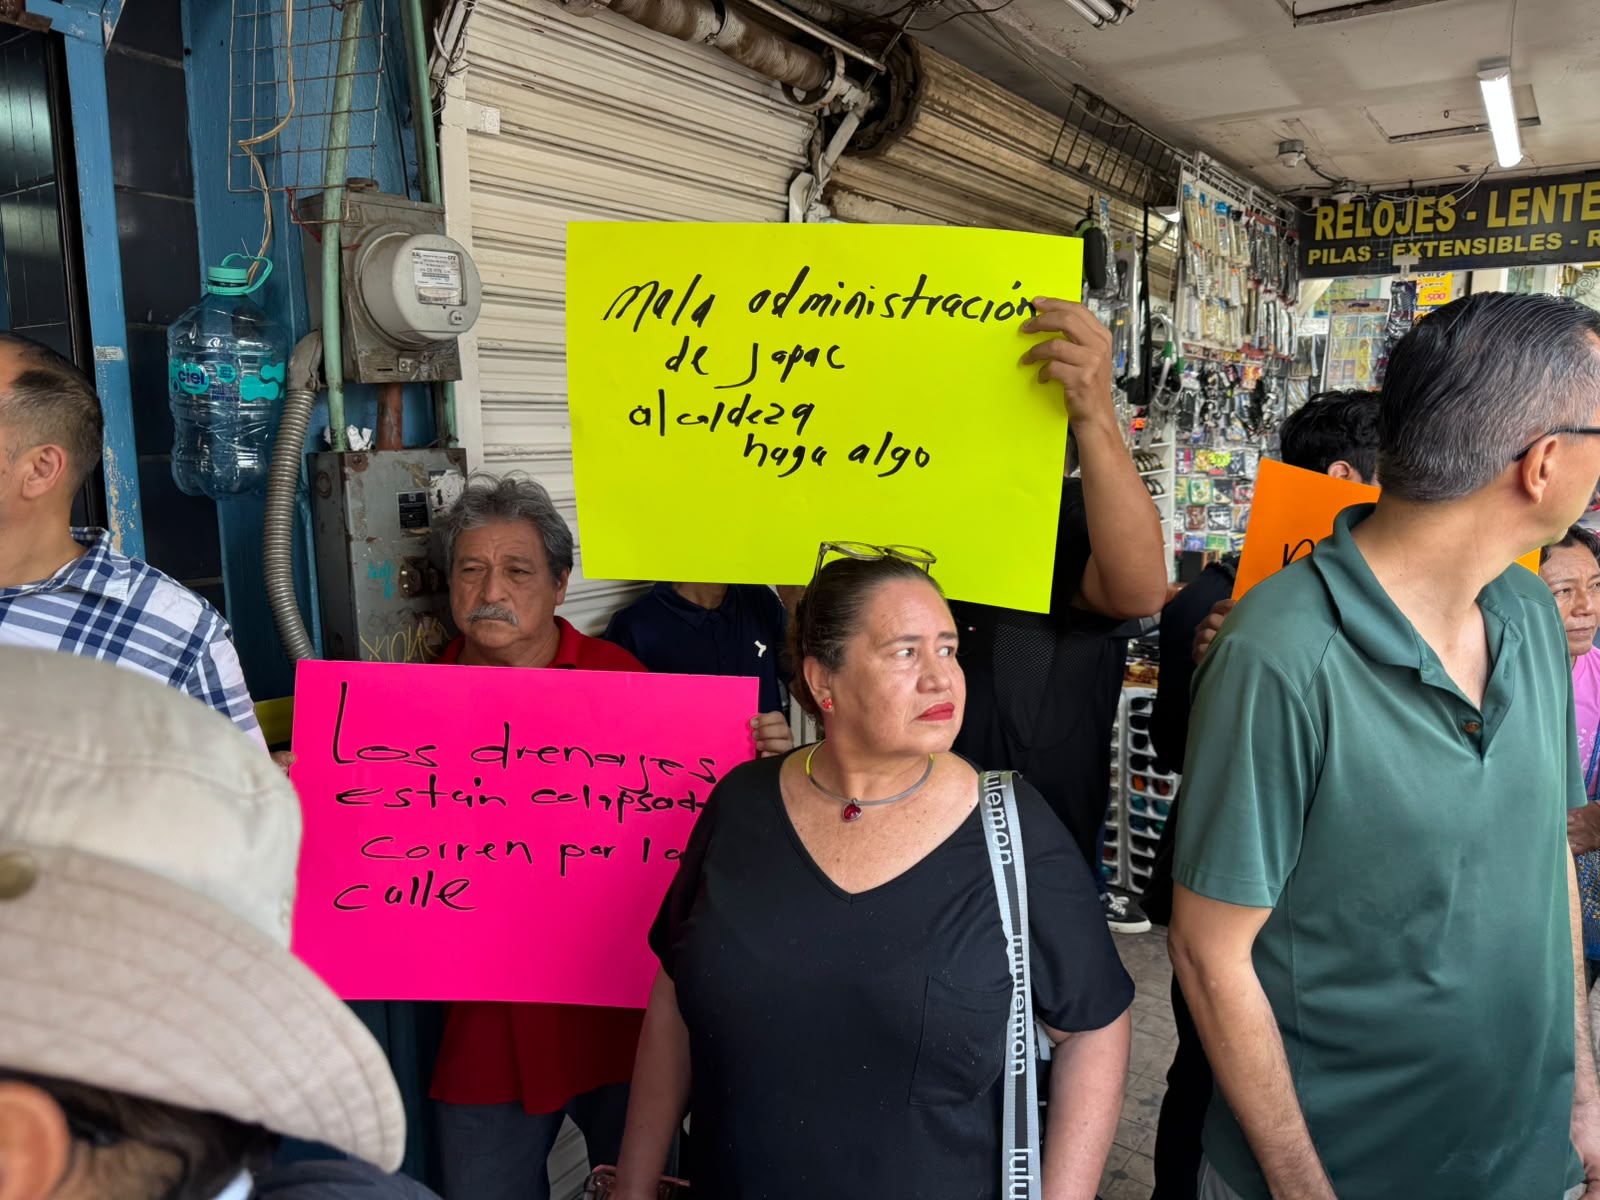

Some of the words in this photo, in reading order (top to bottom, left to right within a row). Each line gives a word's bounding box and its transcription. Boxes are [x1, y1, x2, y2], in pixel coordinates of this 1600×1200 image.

[1315, 193, 1457, 241] RELOJES
[1308, 245, 1372, 265] PILAS
[1392, 232, 1562, 260] EXTENSIBLES
[749, 266, 1036, 323] administración
[178, 368, 206, 385] ciel
[665, 336, 708, 375] de
[744, 433, 827, 477] haga
[848, 431, 929, 477] algo
[333, 682, 437, 767] Los
[471, 723, 717, 793] drenajes
[560, 845, 614, 876] por
